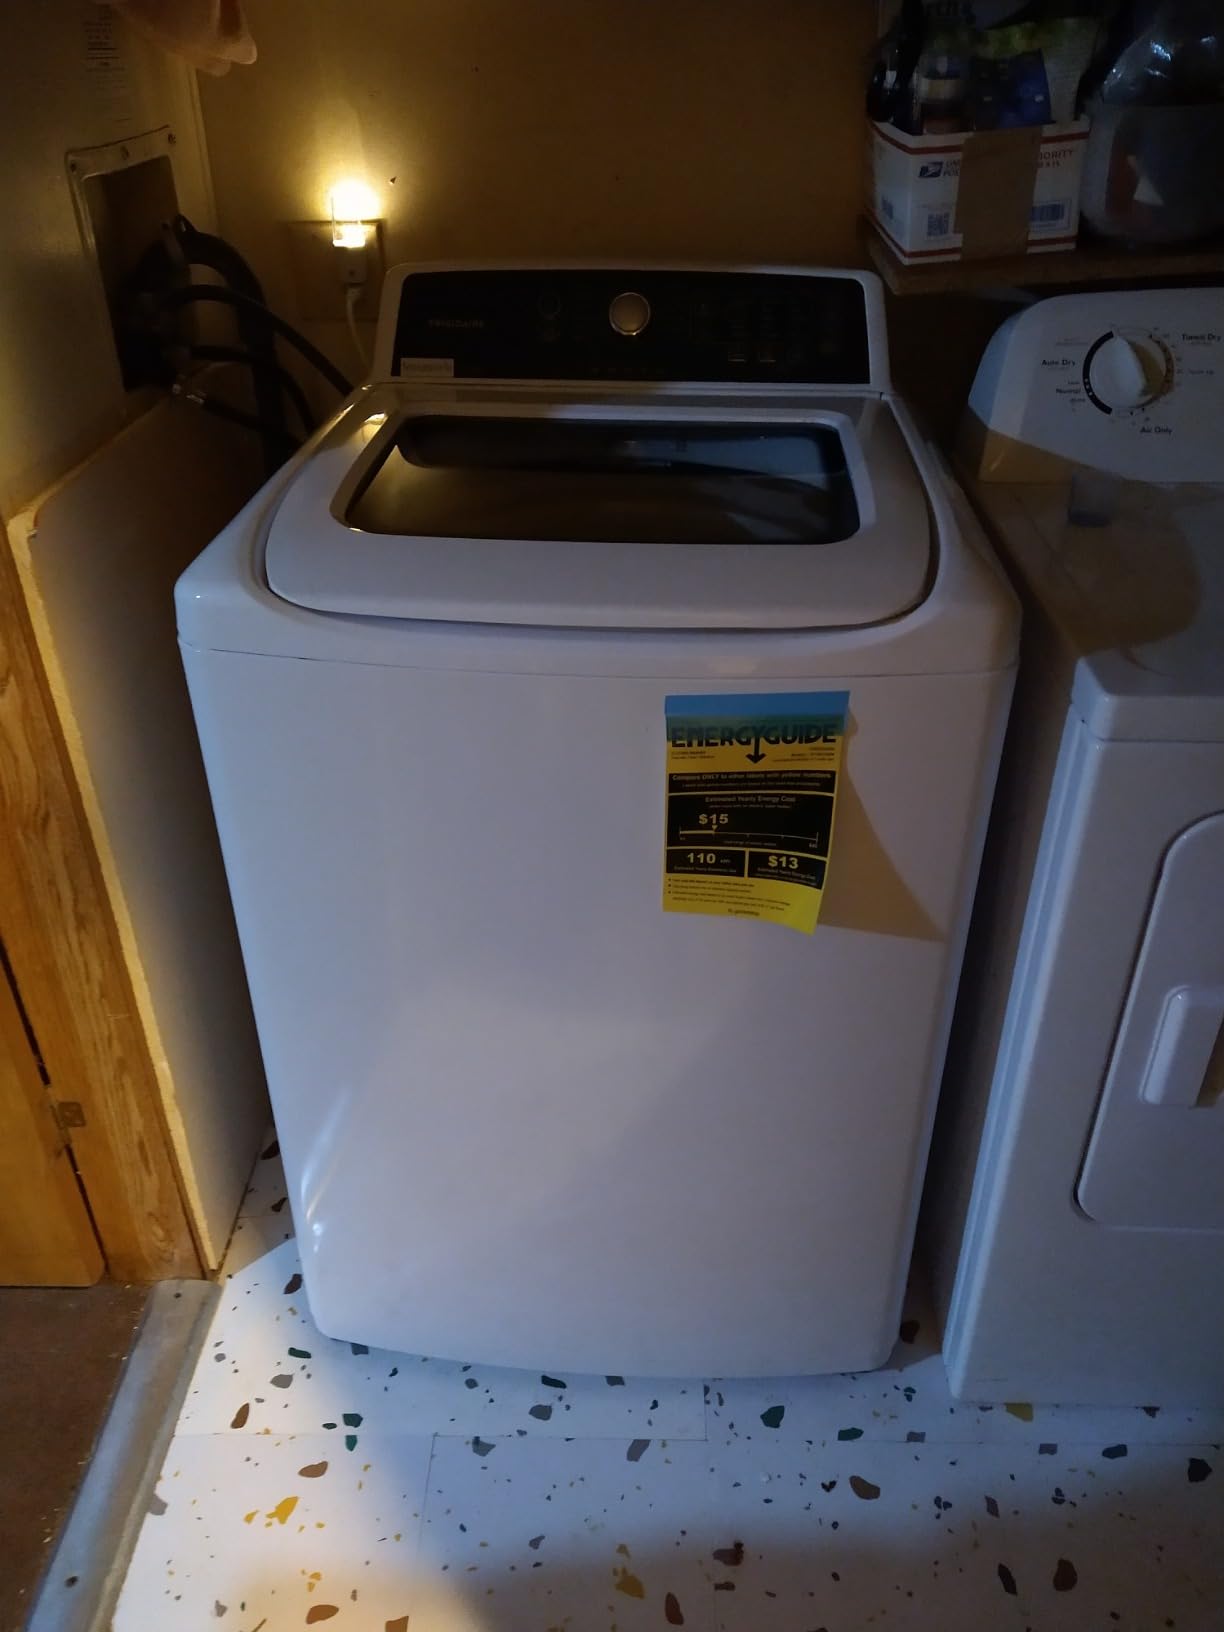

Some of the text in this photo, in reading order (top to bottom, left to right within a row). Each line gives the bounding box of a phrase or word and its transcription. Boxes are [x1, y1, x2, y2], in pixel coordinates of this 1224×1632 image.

[1062, 359, 1076, 367] Dry
[698, 813, 729, 825] $15
[687, 852, 717, 865] 110
[768, 855, 800, 870] $13
